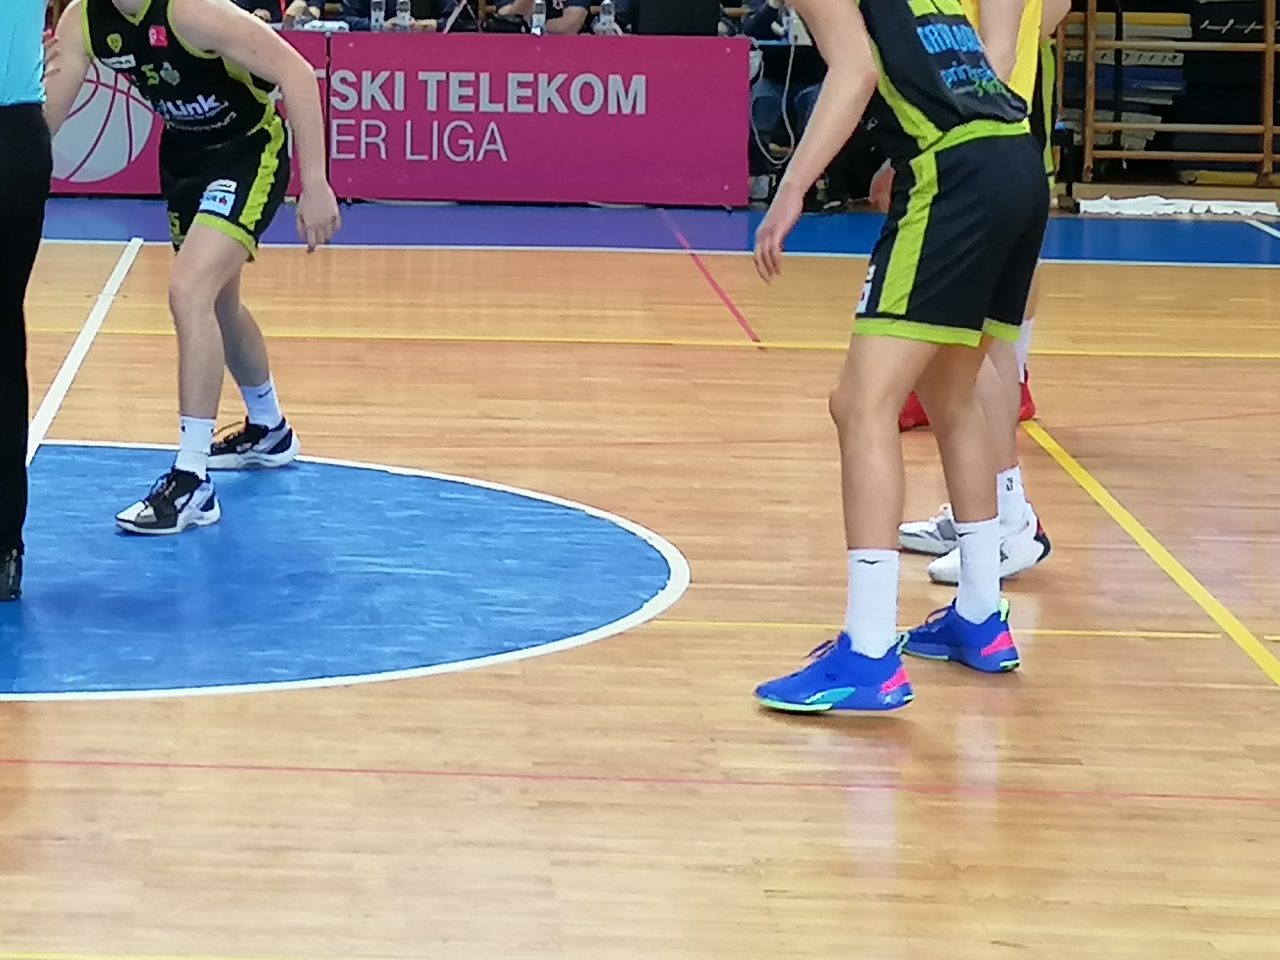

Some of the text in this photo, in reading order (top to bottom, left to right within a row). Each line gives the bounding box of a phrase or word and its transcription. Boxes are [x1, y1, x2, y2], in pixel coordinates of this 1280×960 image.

[141, 64, 160, 86] 5
[314, 69, 647, 115] SKI TELEKOM
[331, 118, 508, 162] ER LIGA
